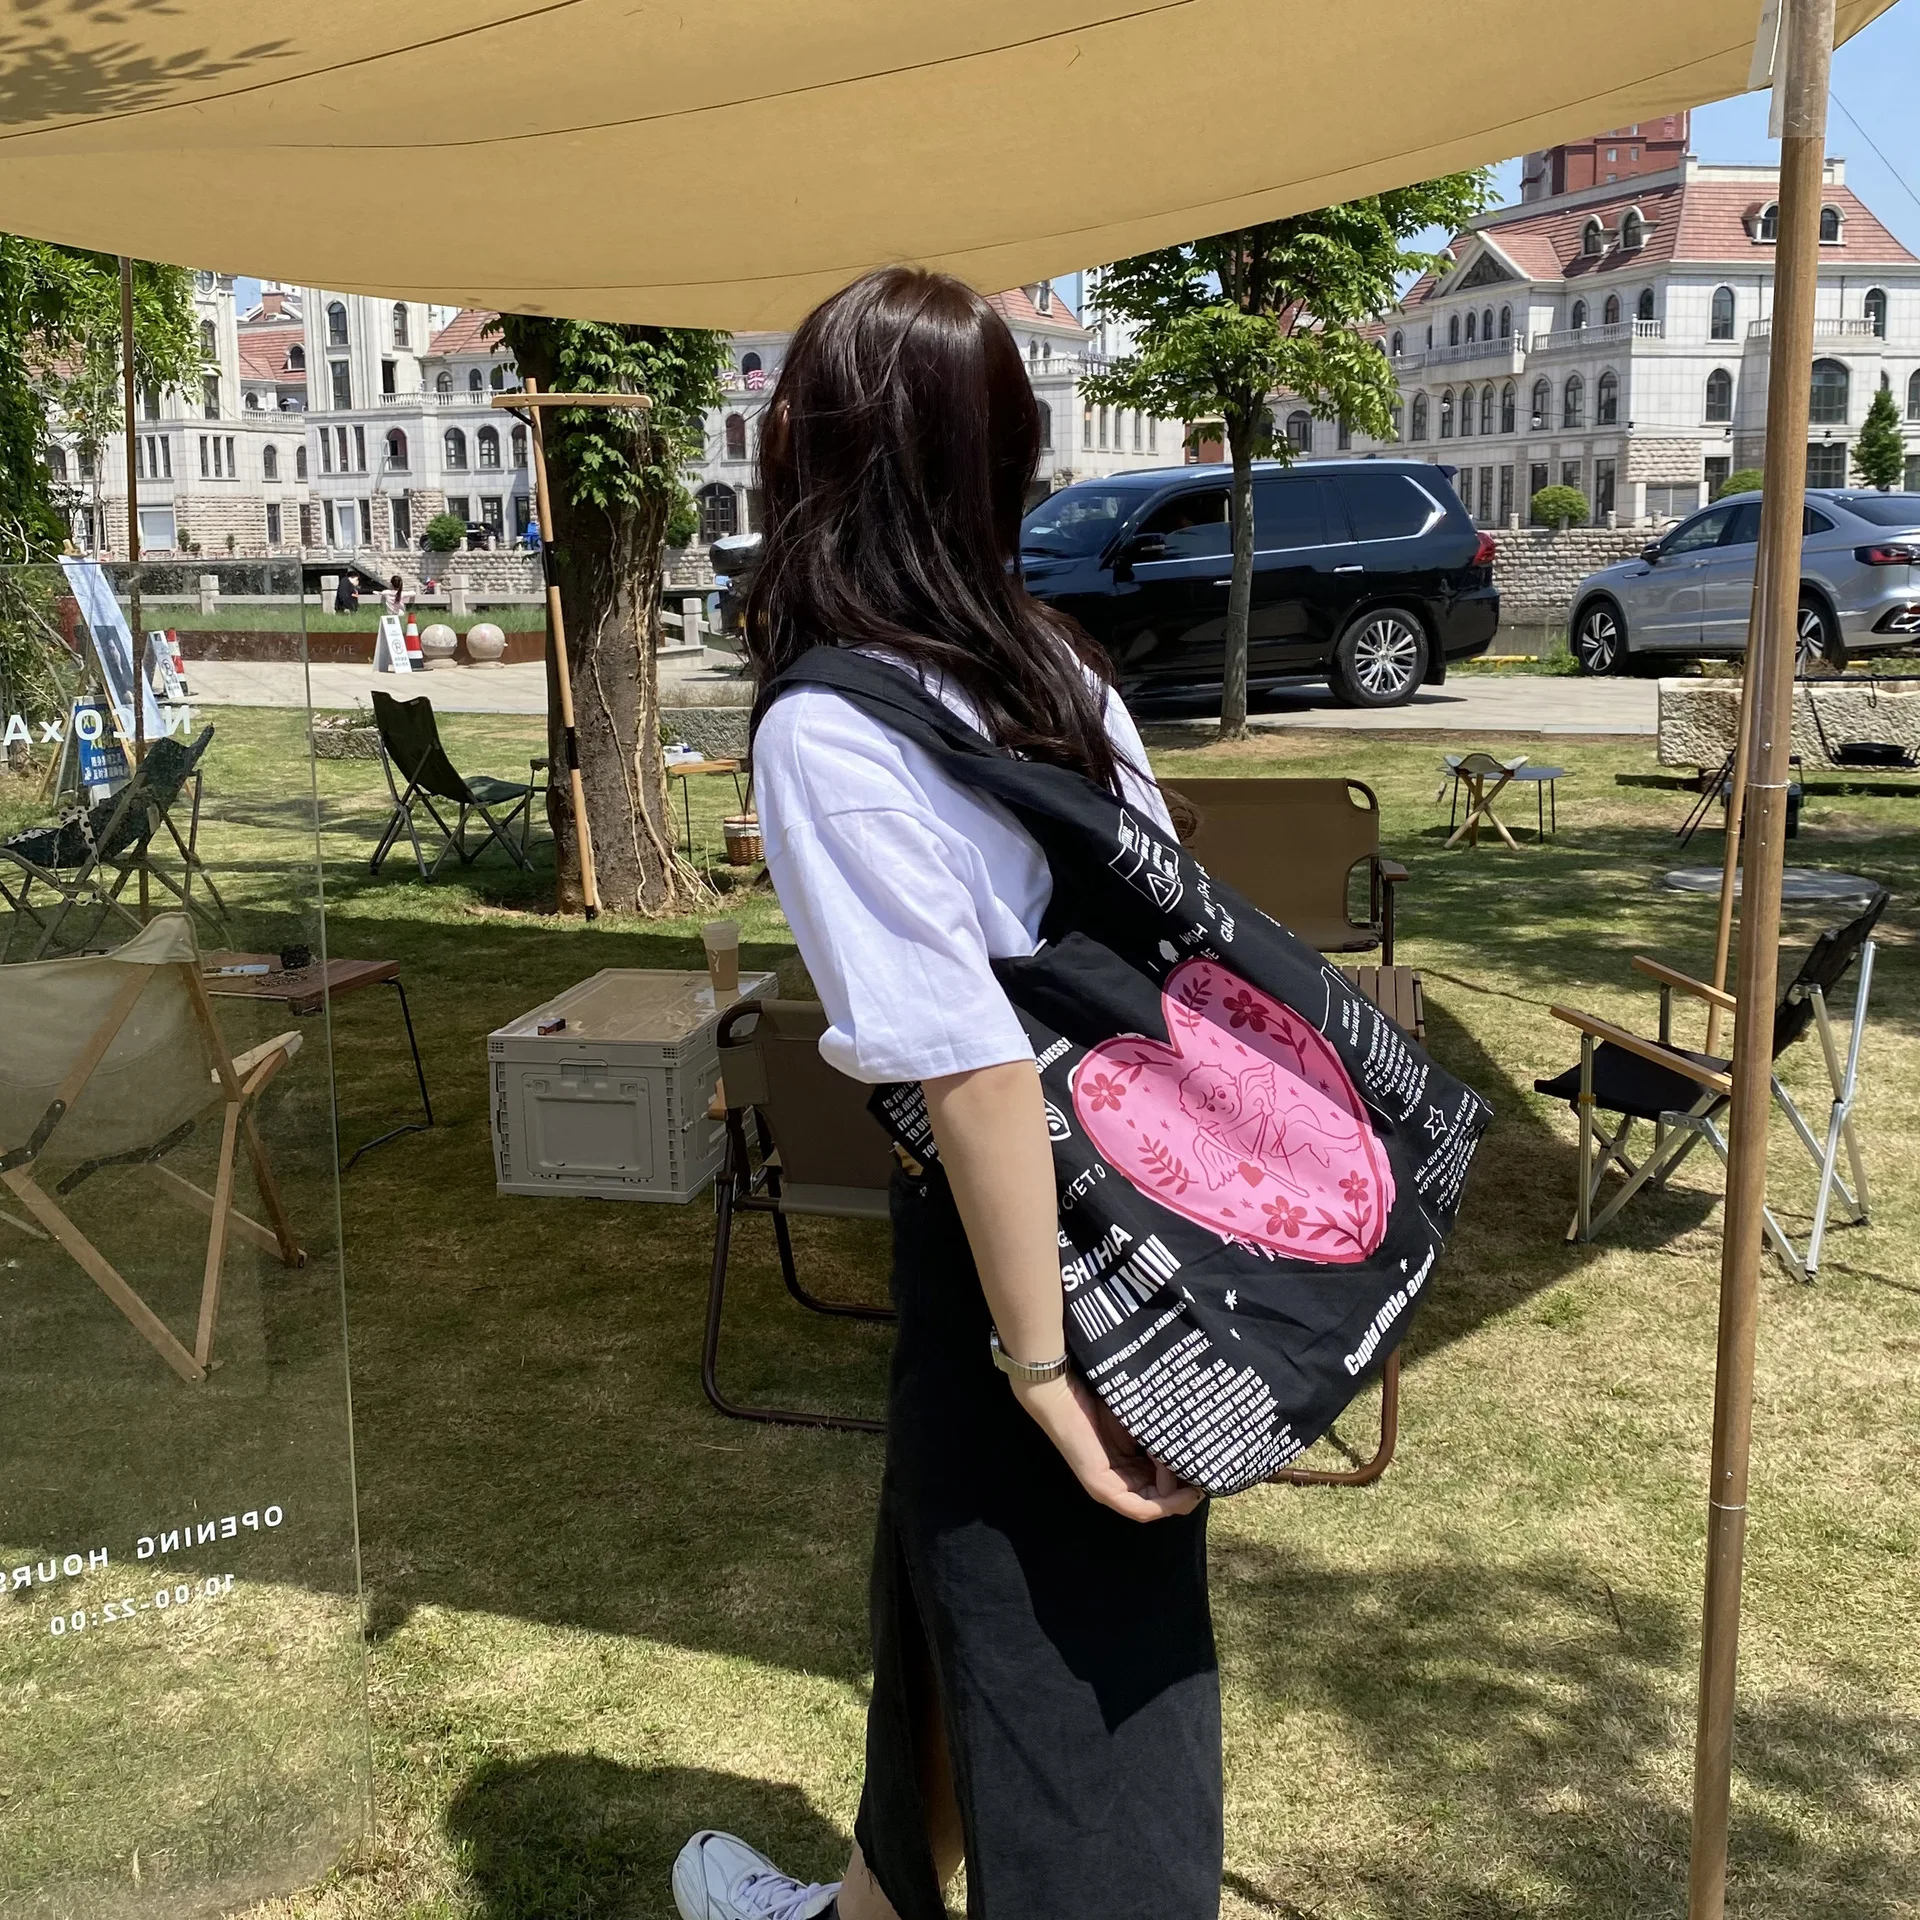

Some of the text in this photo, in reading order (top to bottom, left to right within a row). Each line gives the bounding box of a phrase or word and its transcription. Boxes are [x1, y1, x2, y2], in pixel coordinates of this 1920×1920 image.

[1371, 1076, 1384, 1088] BE
[1379, 1076, 1399, 1097] LOVE
[1395, 1078, 1407, 1095] YOU
[1399, 1087, 1424, 1122] ANOTHER
[905, 1127, 920, 1141] TO
[1413, 1165, 1429, 1183] WILL
[1427, 1147, 1443, 1166] GIVE
[1440, 1133, 1453, 1151] YOU
[1449, 1121, 1460, 1136] ALL
[1418, 1161, 1446, 1195] NOTHING
[1436, 1188, 1449, 1205] YOU
[1095, 1339, 1142, 1375] HAPPINESS
[1139, 1326, 1157, 1346] AND
[1153, 1300, 1187, 1331] SADNESS
[1343, 1321, 1381, 1376] Cupid
[1375, 1290, 1408, 1334] little
[1110, 1370, 1130, 1388] LIFE
[1119, 1377, 1143, 1398] FADE
[1139, 1359, 1162, 1384] AWAY
[1159, 1342, 1185, 1365] WITH
[1181, 1328, 1206, 1348] TIME.
[1119, 1392, 1143, 1413] NOW
[1140, 1383, 1154, 1398] ON
[1151, 1367, 1173, 1389] LOVE
[1127, 1397, 1156, 1423] LIVING
[1152, 1380, 1176, 1402] THEN
[1173, 1361, 1201, 1386] SMILE
[1127, 1358, 1227, 1438] WILL NOT BE THE SAME AS
[1141, 1424, 1161, 1443] YOU
[1157, 1405, 1185, 1431] WANT
[1217, 1366, 1237, 1386] AND
[1207, 1399, 1235, 1425] KNEW
[1231, 1383, 1254, 1406] HOW
[1249, 1375, 1263, 1390] TO
[1166, 1422, 1184, 1441] GET
[1181, 1415, 1193, 1429] IT
[1191, 1426, 1224, 1454] WHOLE
[1219, 1411, 1241, 1432] CITY
[1237, 1404, 1250, 1418] IS
[1246, 1383, 1271, 1410] BLASP
[1194, 1434, 1234, 1469] BYGONES
[1231, 1425, 1245, 1439] BE
[1241, 1396, 1279, 1431] BYGONES.
[1198, 1468, 1214, 1483] BE
[1209, 1439, 1247, 1474] ALLOWED
[1242, 1430, 1257, 1444] TO
[1253, 1412, 1279, 1436] LEAVE.
[1224, 1470, 1245, 1489] YOUR
[1245, 1452, 1262, 1474] PAST
[1255, 1423, 1292, 1457] RELATION
[1232, 1455, 1247, 1471] MY
[1252, 1443, 1281, 1471] SUITED
[1279, 1434, 1291, 1448] TO
[1269, 1437, 1302, 1468] NOTHING
